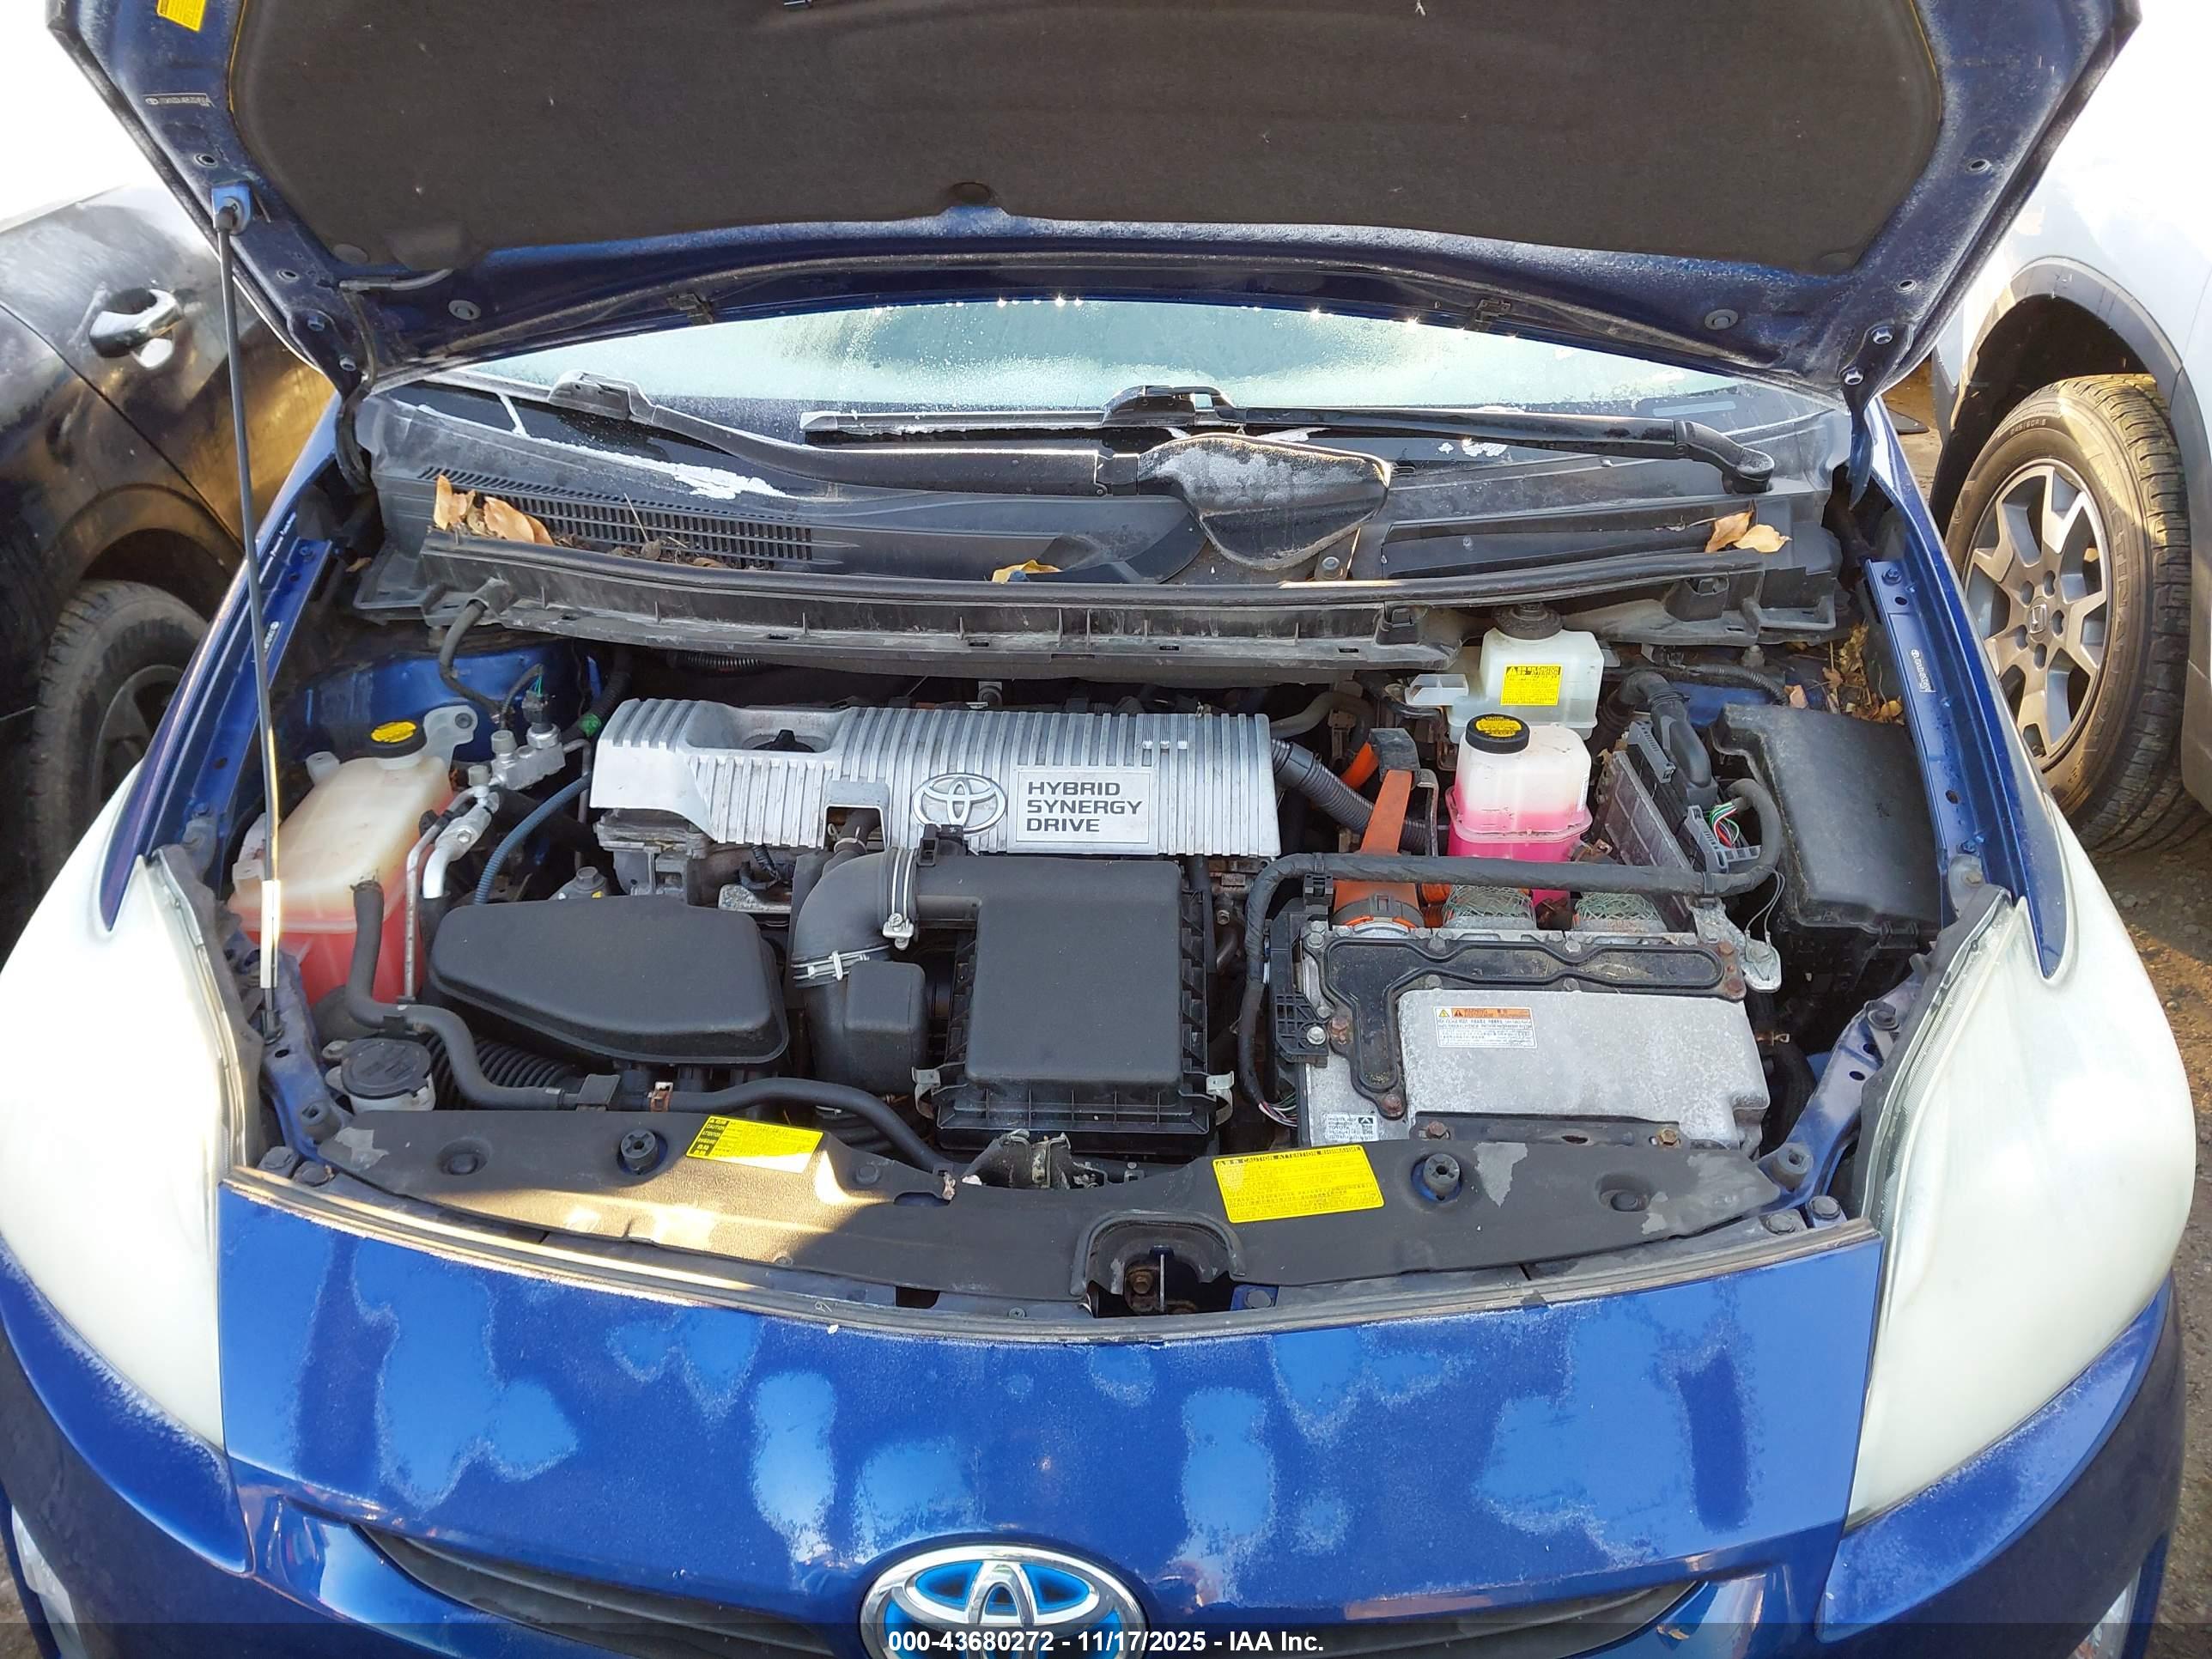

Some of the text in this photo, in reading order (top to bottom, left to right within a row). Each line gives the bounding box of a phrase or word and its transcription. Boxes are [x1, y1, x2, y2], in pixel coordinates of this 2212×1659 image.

[1028, 781, 1121, 796] HYBRID
[1027, 799, 1143, 815] SYNERGY
[1026, 817, 1100, 832] DRIVE
